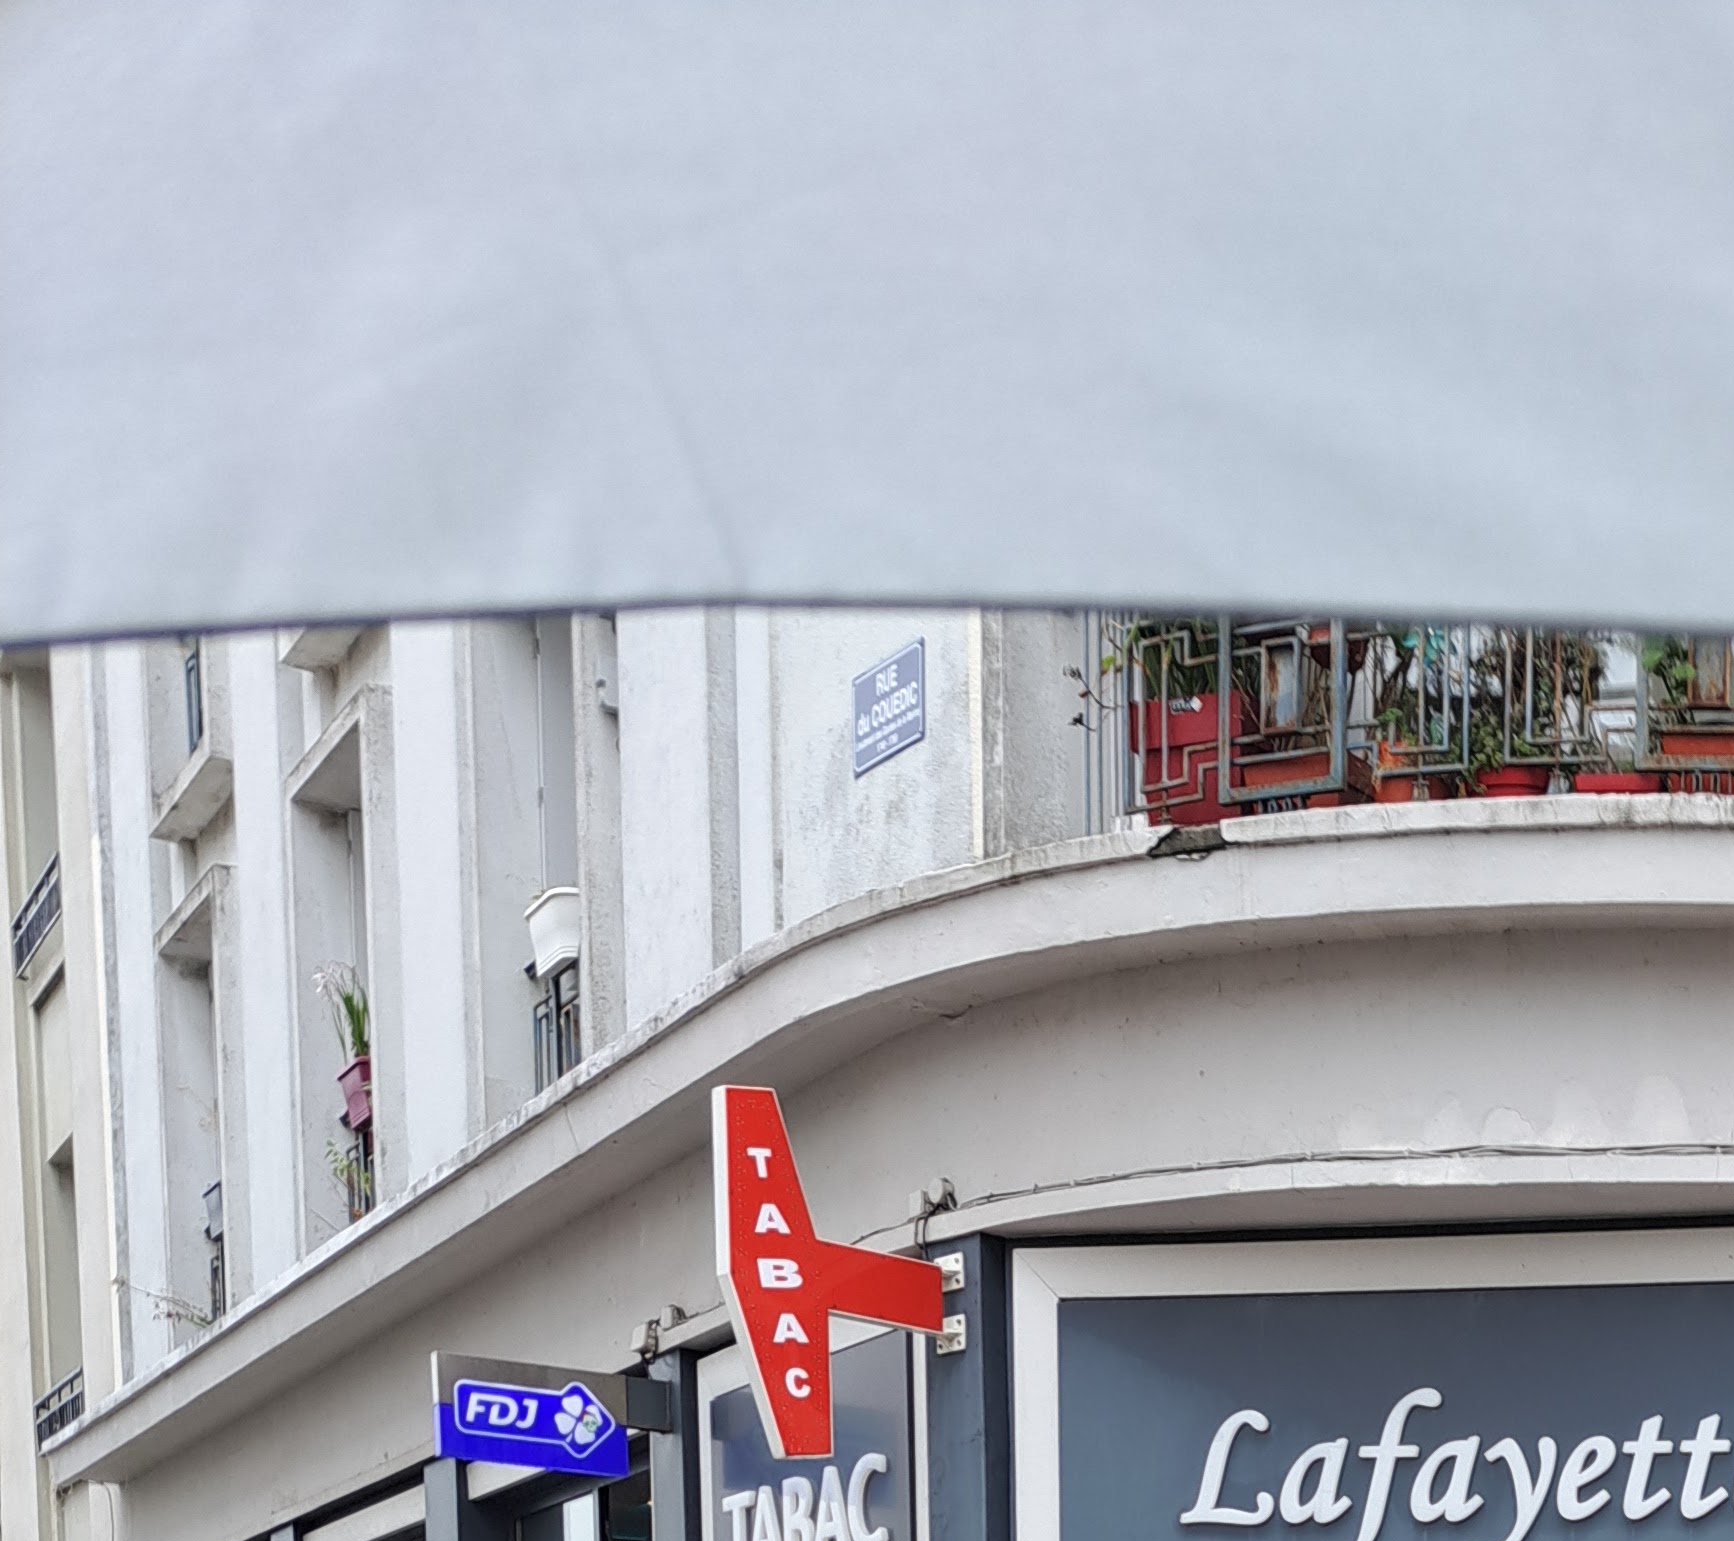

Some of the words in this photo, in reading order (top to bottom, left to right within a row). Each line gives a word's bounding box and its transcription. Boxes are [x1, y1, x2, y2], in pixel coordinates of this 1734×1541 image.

[875, 664, 898, 697] RUE
[746, 1147, 812, 1399] TABAC
[464, 1392, 540, 1429] FDJ
